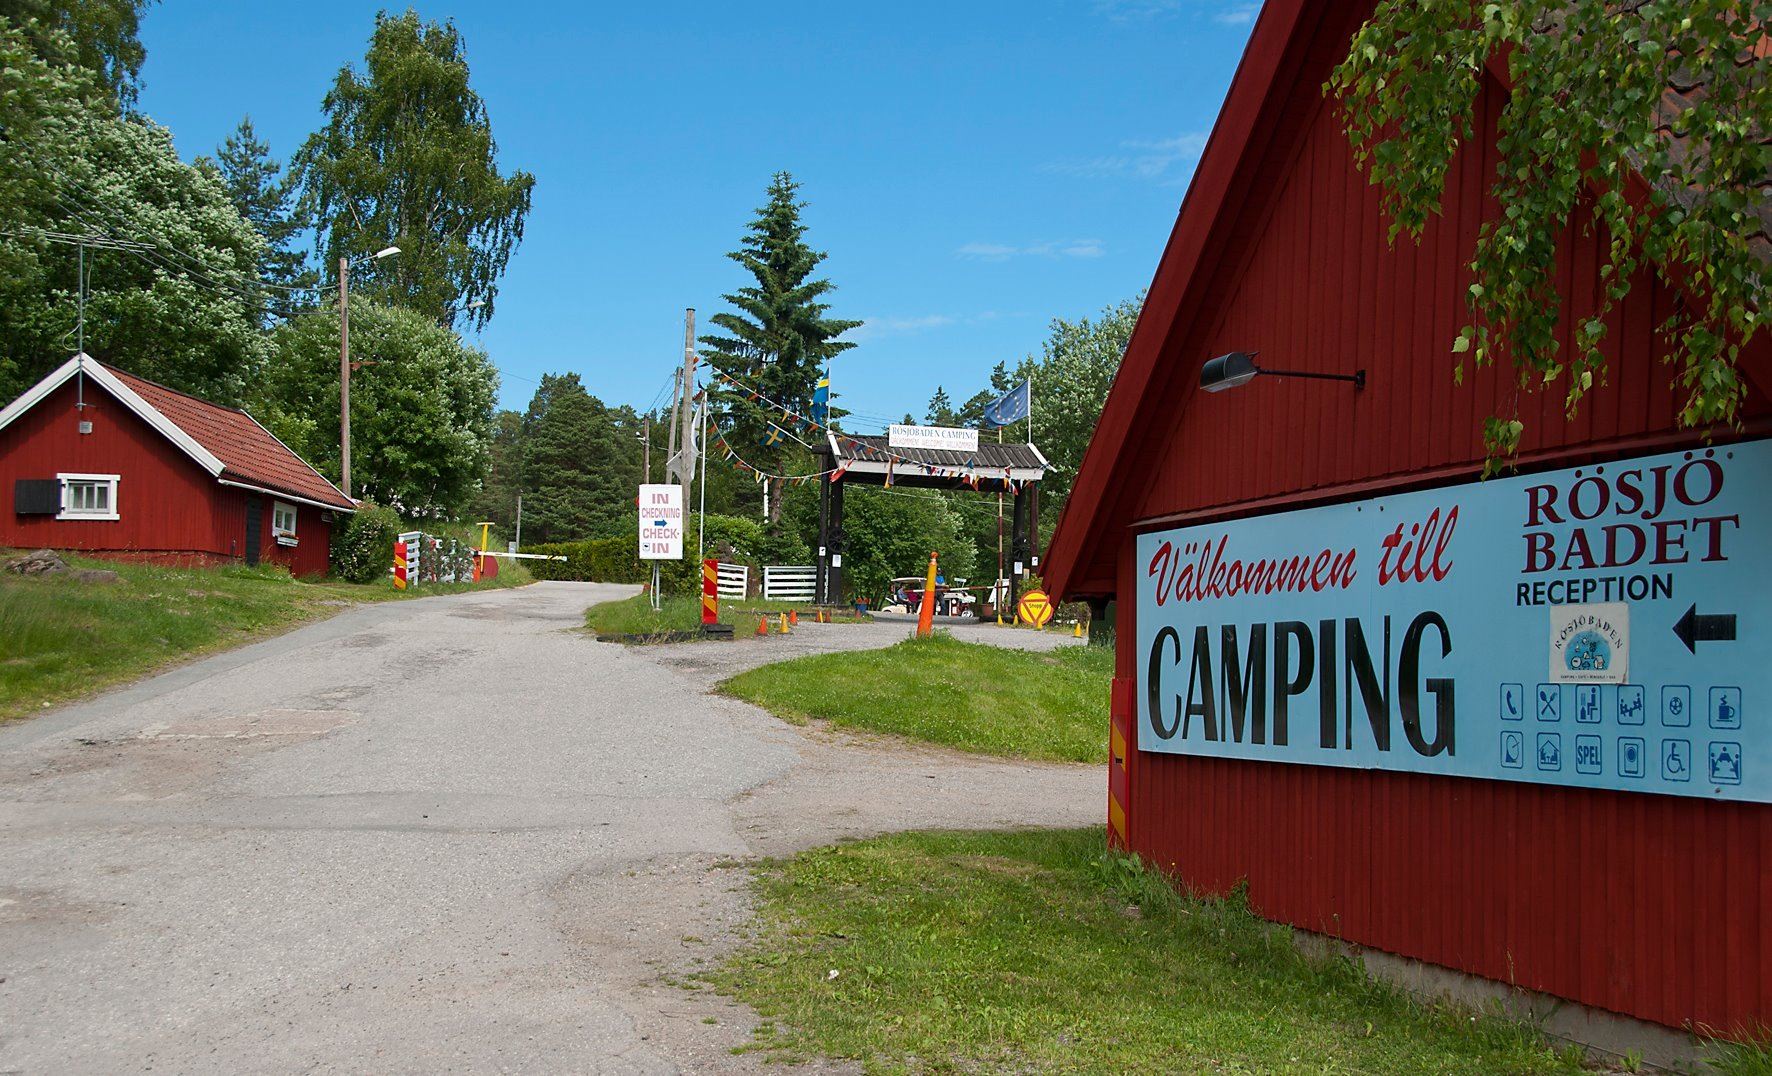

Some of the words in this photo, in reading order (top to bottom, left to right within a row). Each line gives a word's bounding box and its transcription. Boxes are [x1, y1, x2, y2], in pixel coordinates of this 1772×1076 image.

[941, 429, 976, 440] CAMPING
[652, 493, 669, 504] IN
[1523, 449, 1724, 528] RÖSJÖ
[641, 507, 680, 518] CHECKNING
[652, 542, 669, 553] IN
[1149, 534, 1357, 607] Välkommen
[1378, 504, 1459, 586] till
[1521, 513, 1740, 574] BADET
[1516, 573, 1673, 607] RECEPTION
[1147, 610, 1456, 758] CAMPING
[1577, 744, 1601, 766] SPEL
